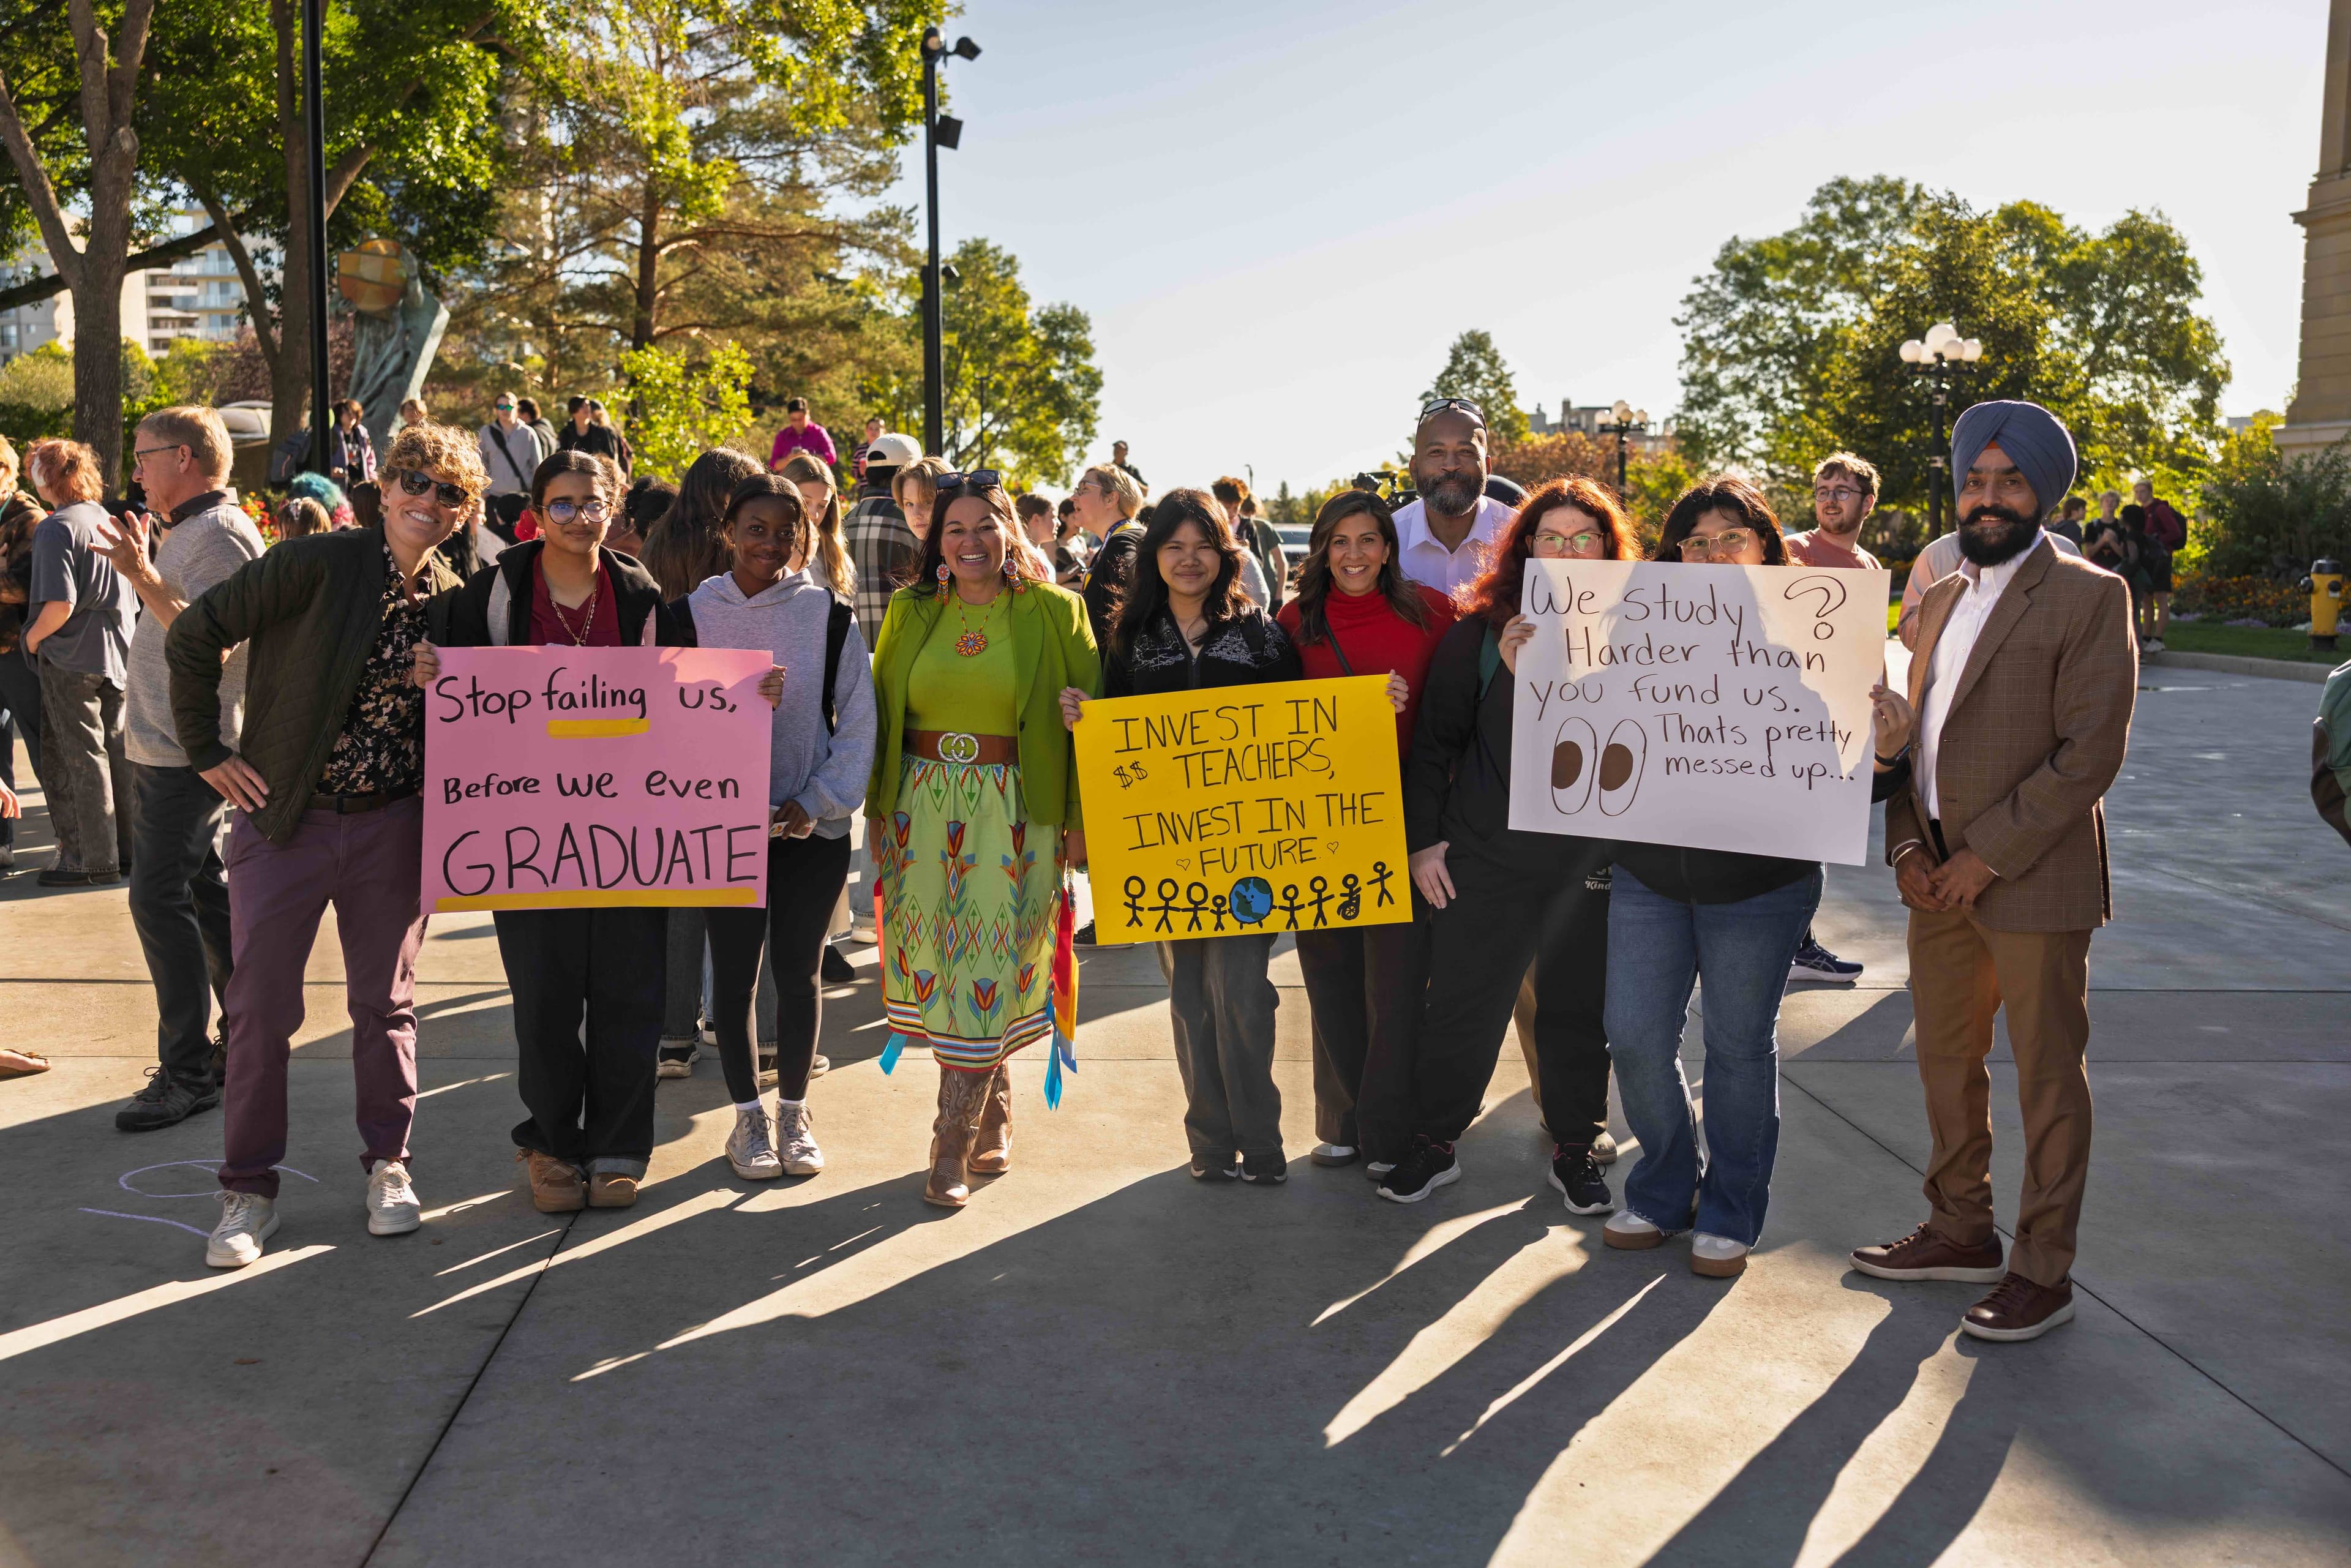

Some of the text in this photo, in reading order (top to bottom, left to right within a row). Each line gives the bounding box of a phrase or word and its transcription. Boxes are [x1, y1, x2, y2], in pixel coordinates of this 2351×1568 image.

[1531, 575, 1600, 616] We
[1565, 626, 1826, 673] Harder than
[436, 667, 737, 724] Stop failing us,
[1529, 673, 1800, 721] you fund us.
[1112, 695, 1338, 753] INVEST IN
[1653, 713, 1851, 756] Thats pretty
[444, 773, 540, 805] Before
[645, 770, 739, 799] even
[1113, 738, 1335, 790] $$ TEACHERS,
[1665, 754, 1855, 790] messed up...
[1123, 792, 1385, 850] INVEST IN THE
[443, 823, 761, 896] GRADUATE
